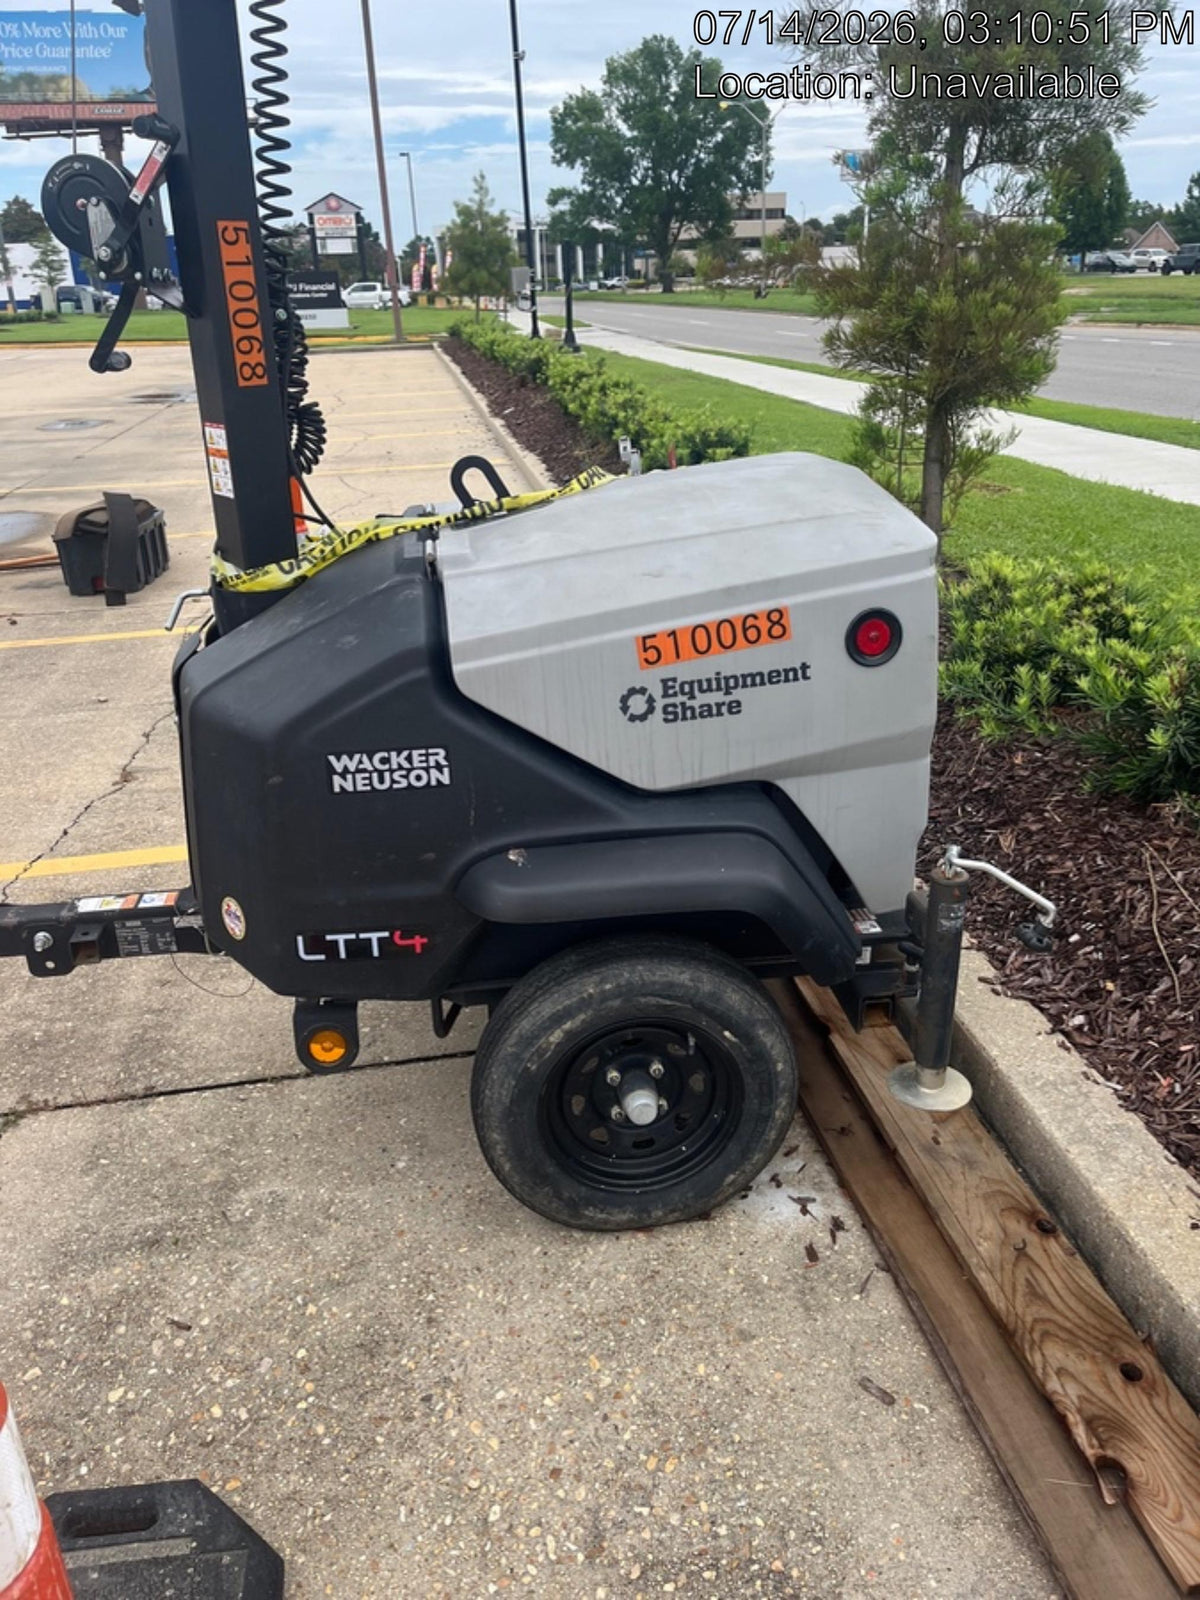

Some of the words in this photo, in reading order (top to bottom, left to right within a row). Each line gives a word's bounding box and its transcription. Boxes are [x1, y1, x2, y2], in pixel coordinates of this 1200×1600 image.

[23, 22, 63, 38] More
[63, 22, 98, 38] With
[100, 23, 128, 38] Our
[221, 226, 266, 382] 510068
[640, 607, 788, 667] 510068
[660, 662, 811, 700] Equipment
[662, 698, 742, 724] Share
[327, 748, 449, 774] WACKER
[332, 767, 450, 793] NEUSON
[296, 930, 428, 961] LTT4
